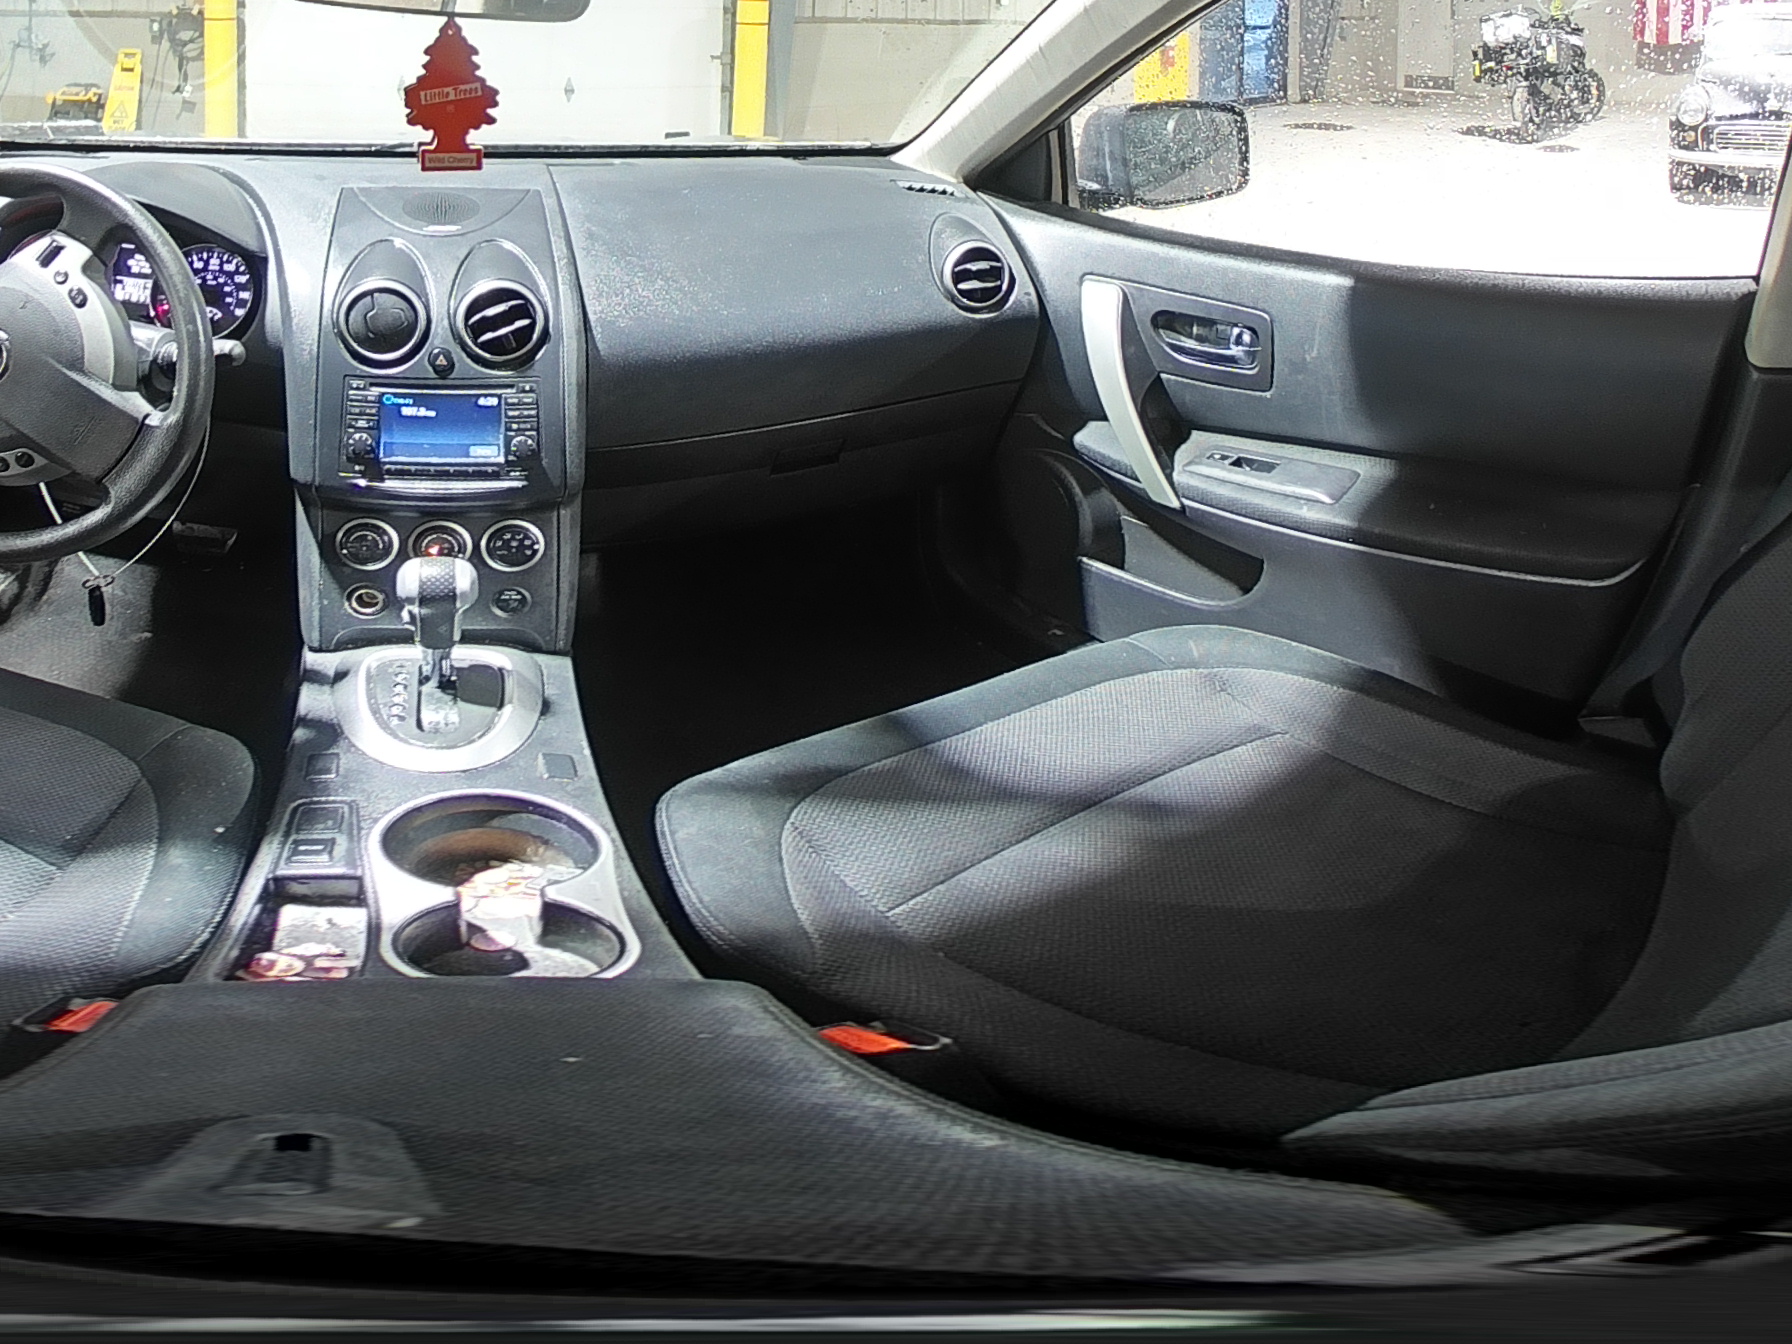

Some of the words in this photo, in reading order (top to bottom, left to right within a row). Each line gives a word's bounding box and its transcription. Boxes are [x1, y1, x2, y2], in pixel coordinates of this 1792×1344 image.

[424, 89, 451, 103] Little
[452, 85, 479, 98] Trees
[447, 156, 475, 165] Cherry
